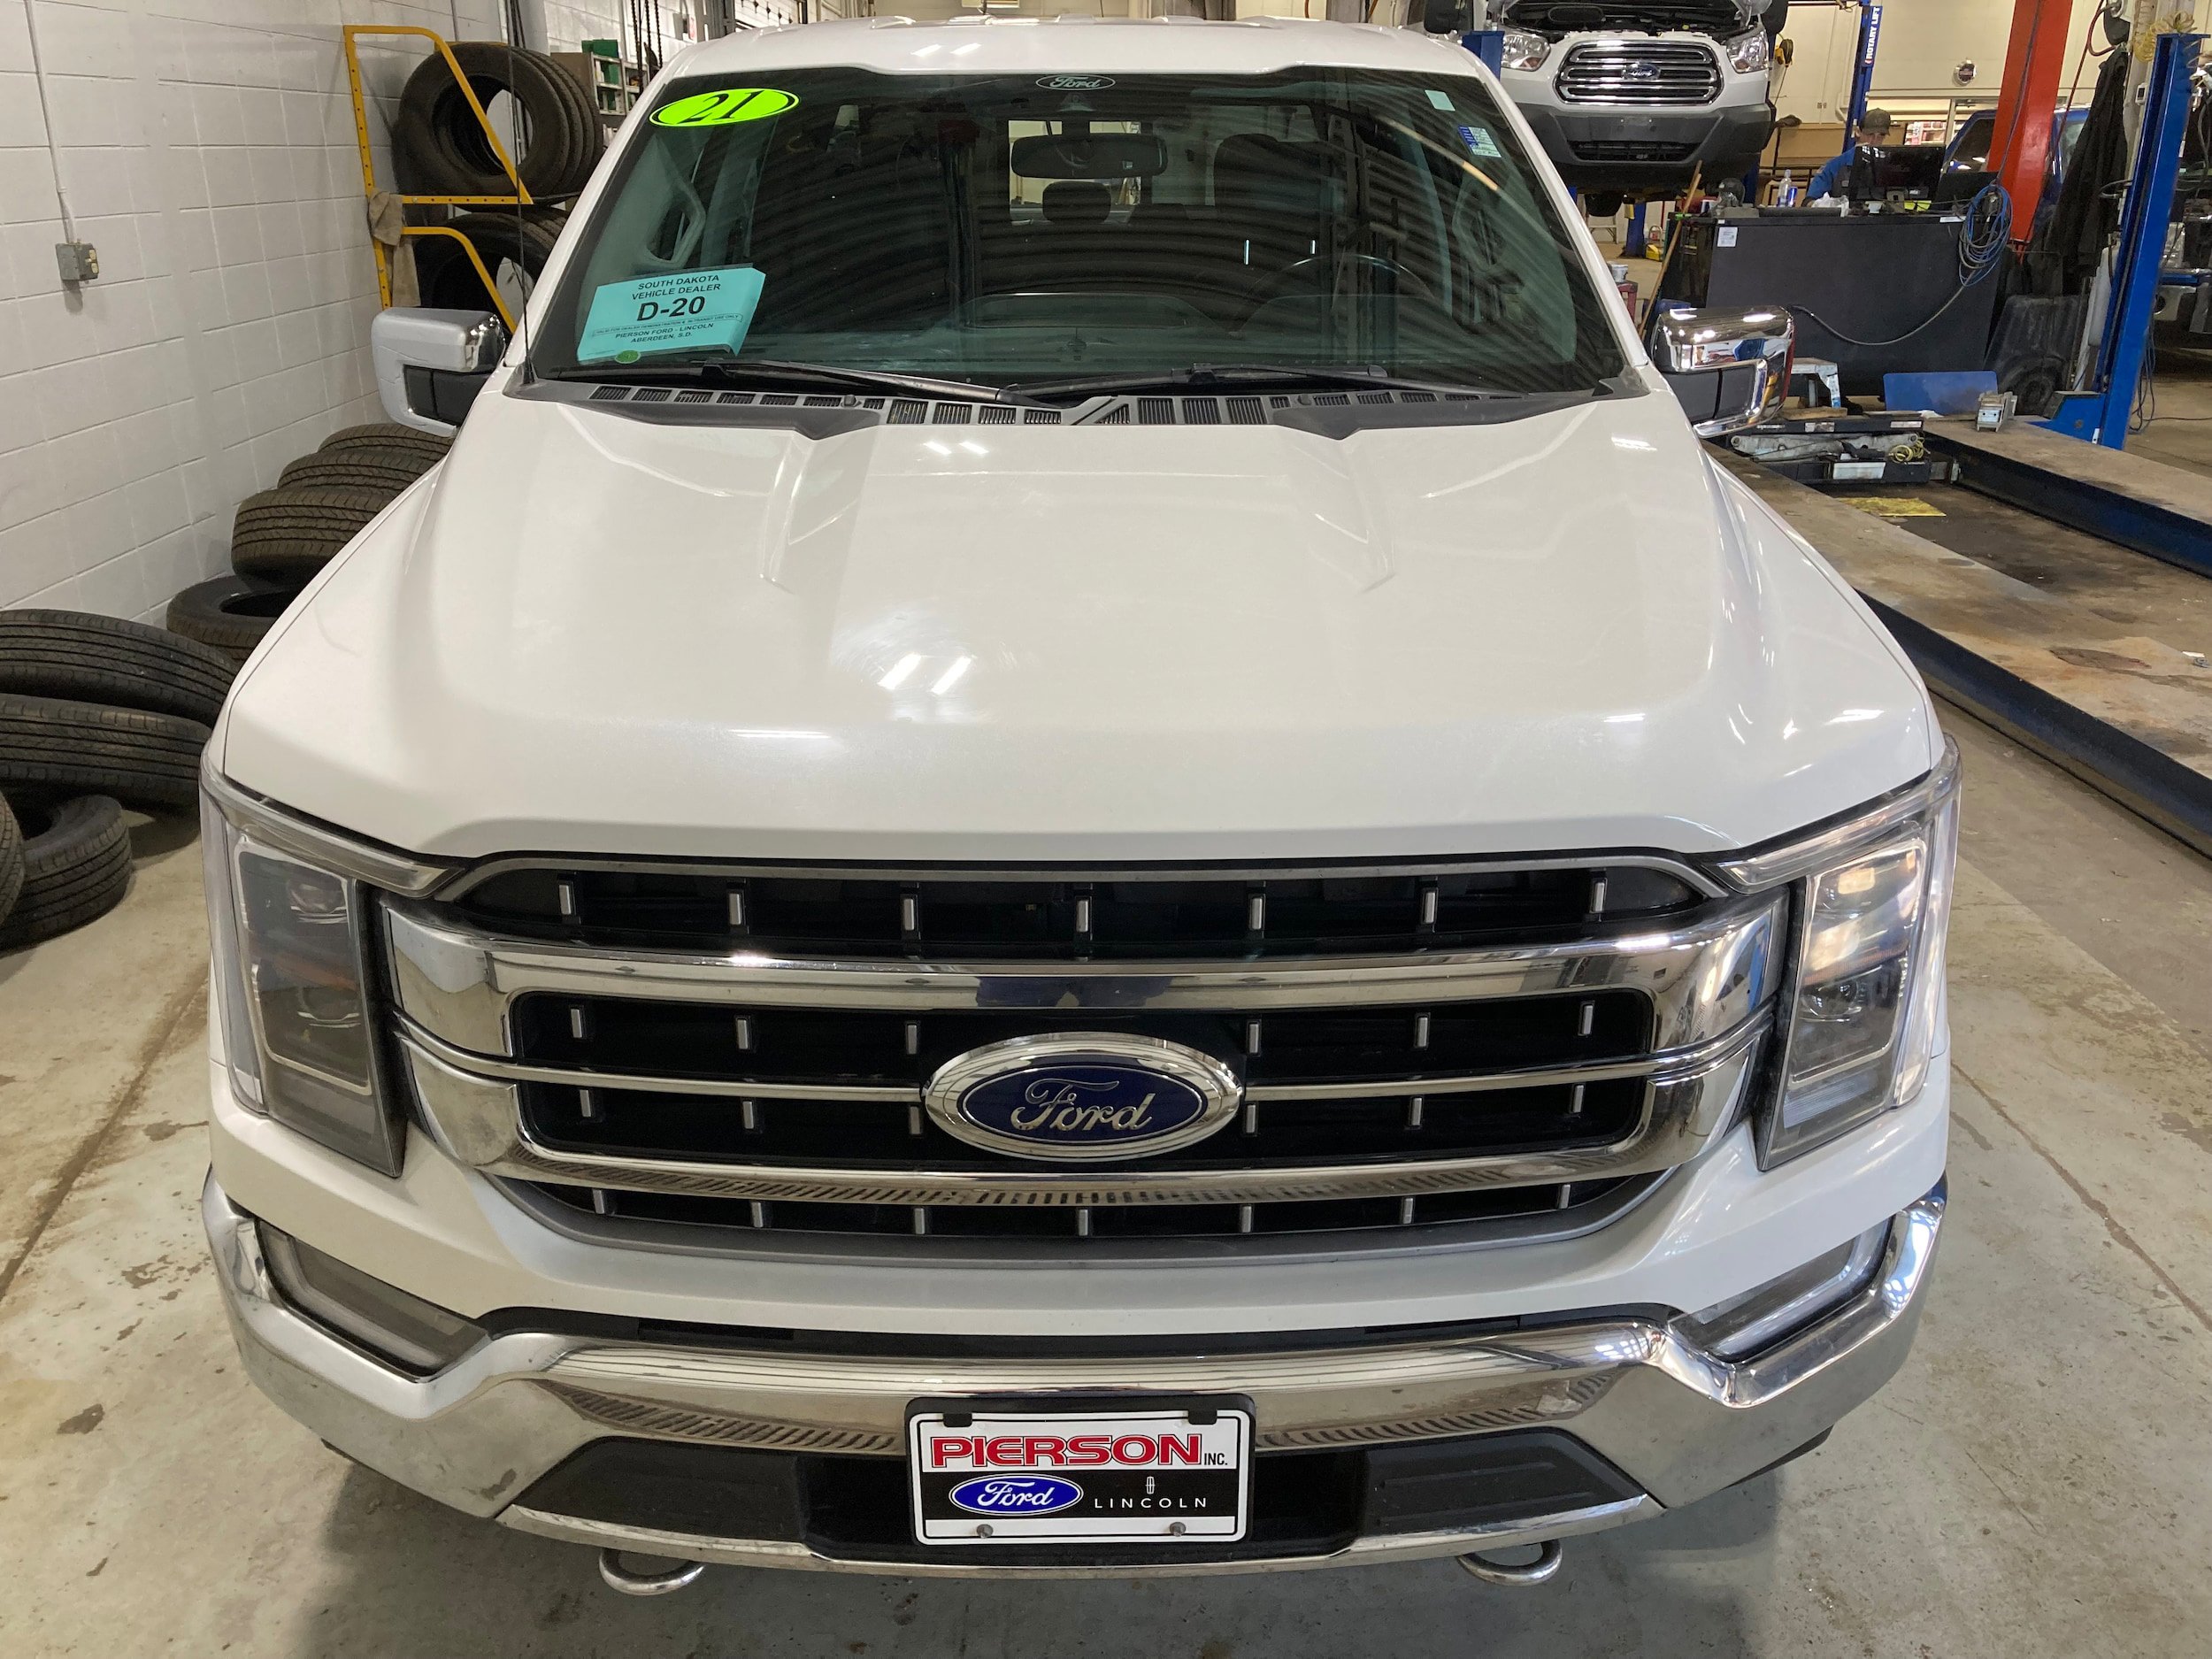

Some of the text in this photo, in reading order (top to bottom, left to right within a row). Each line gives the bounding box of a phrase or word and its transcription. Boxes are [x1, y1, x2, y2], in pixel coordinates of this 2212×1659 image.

[1866, 6, 1880, 59] ROTARY LIFT
[1049, 76, 1102, 88] Ford
[676, 90, 764, 125] 21
[632, 283, 721, 300] VEHICLE DEALER
[638, 274, 719, 290] SOUTH DAKOTA
[637, 296, 706, 321] D-20
[1010, 1078, 1156, 1132] Ford
[930, 1433, 1228, 1468] PIERSON INC.
[977, 1480, 1056, 1507] Ford
[1094, 1497, 1207, 1509] LINCOLN
